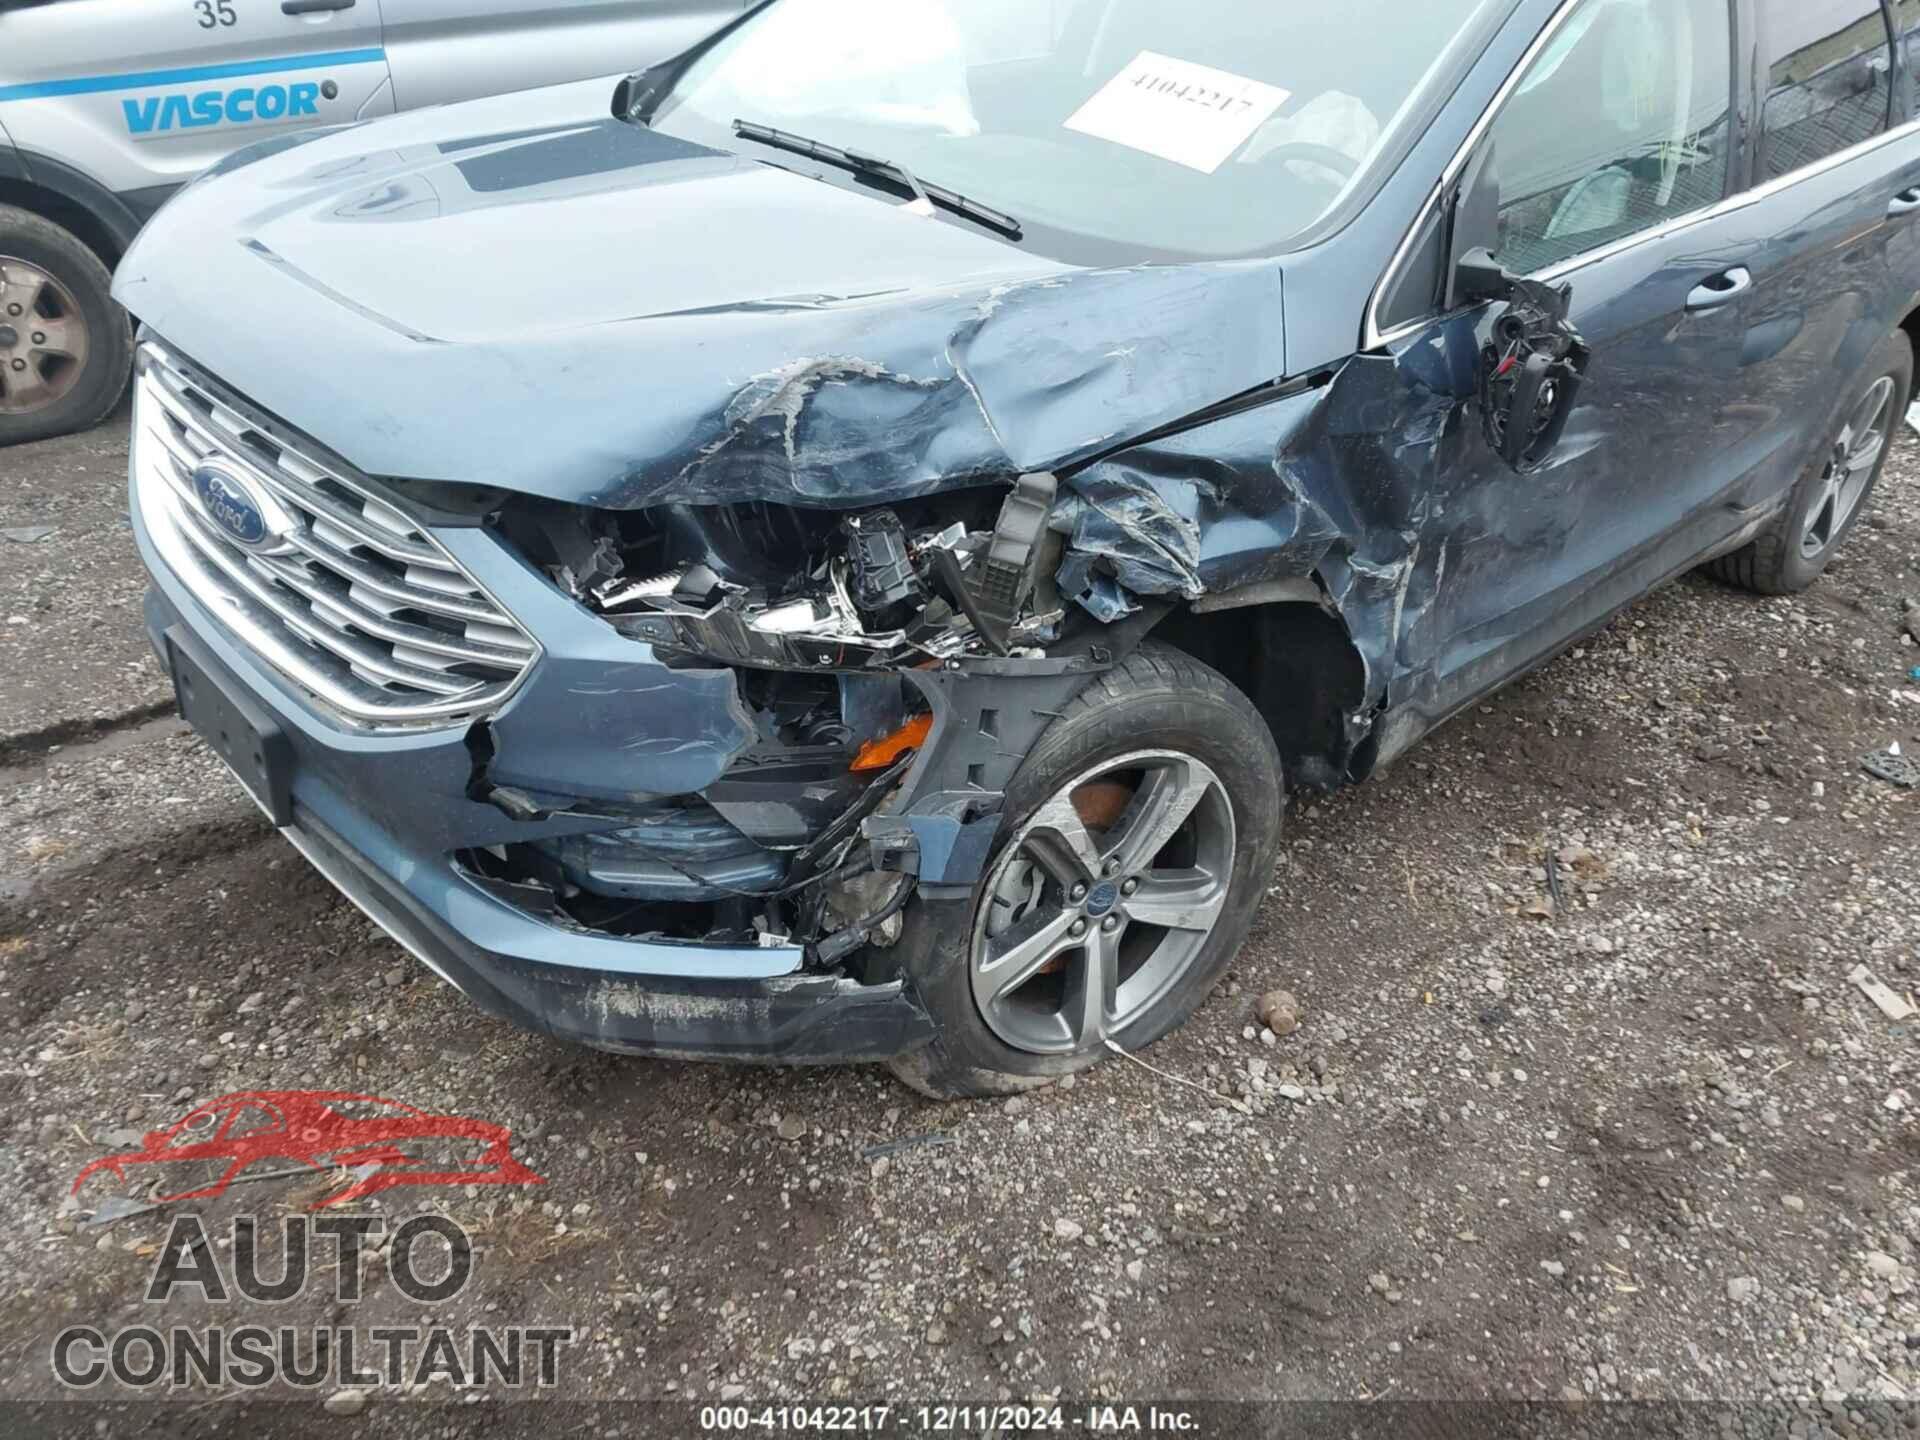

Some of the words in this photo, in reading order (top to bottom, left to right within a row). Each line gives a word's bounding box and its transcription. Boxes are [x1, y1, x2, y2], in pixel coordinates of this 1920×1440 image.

[194, 0, 237, 29] 35
[122, 82, 319, 133] VASCOR
[205, 477, 248, 533] Ford
